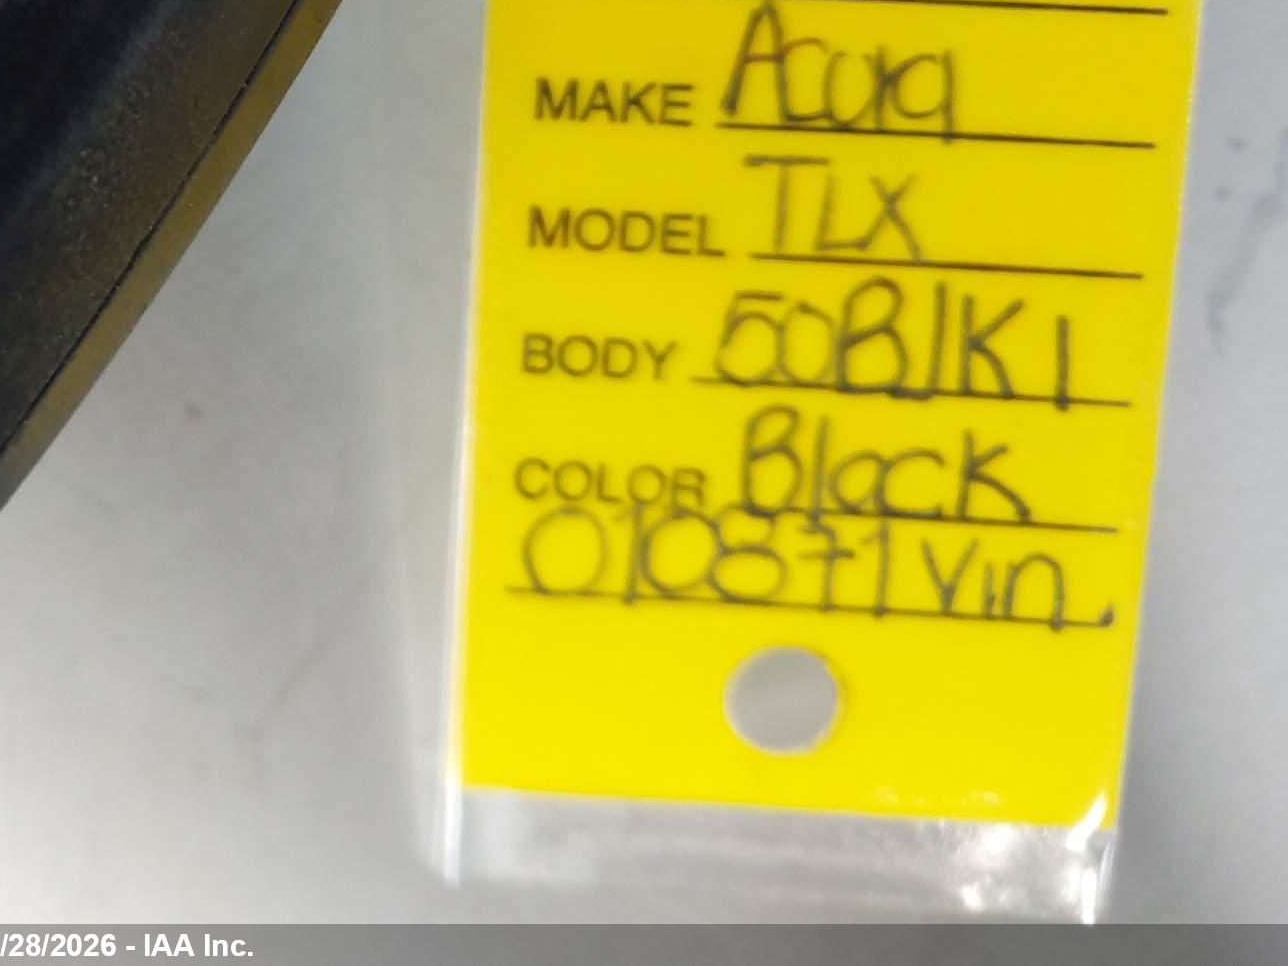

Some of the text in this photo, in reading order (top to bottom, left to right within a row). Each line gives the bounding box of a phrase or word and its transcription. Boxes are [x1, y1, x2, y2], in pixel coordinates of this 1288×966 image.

[534, 78, 694, 126] MAKE
[526, 206, 726, 258] MODEL
[742, 153, 927, 264] TLX
[521, 333, 678, 380] BODY
[513, 457, 707, 508] COLOR
[523, 498, 890, 620] 010871
